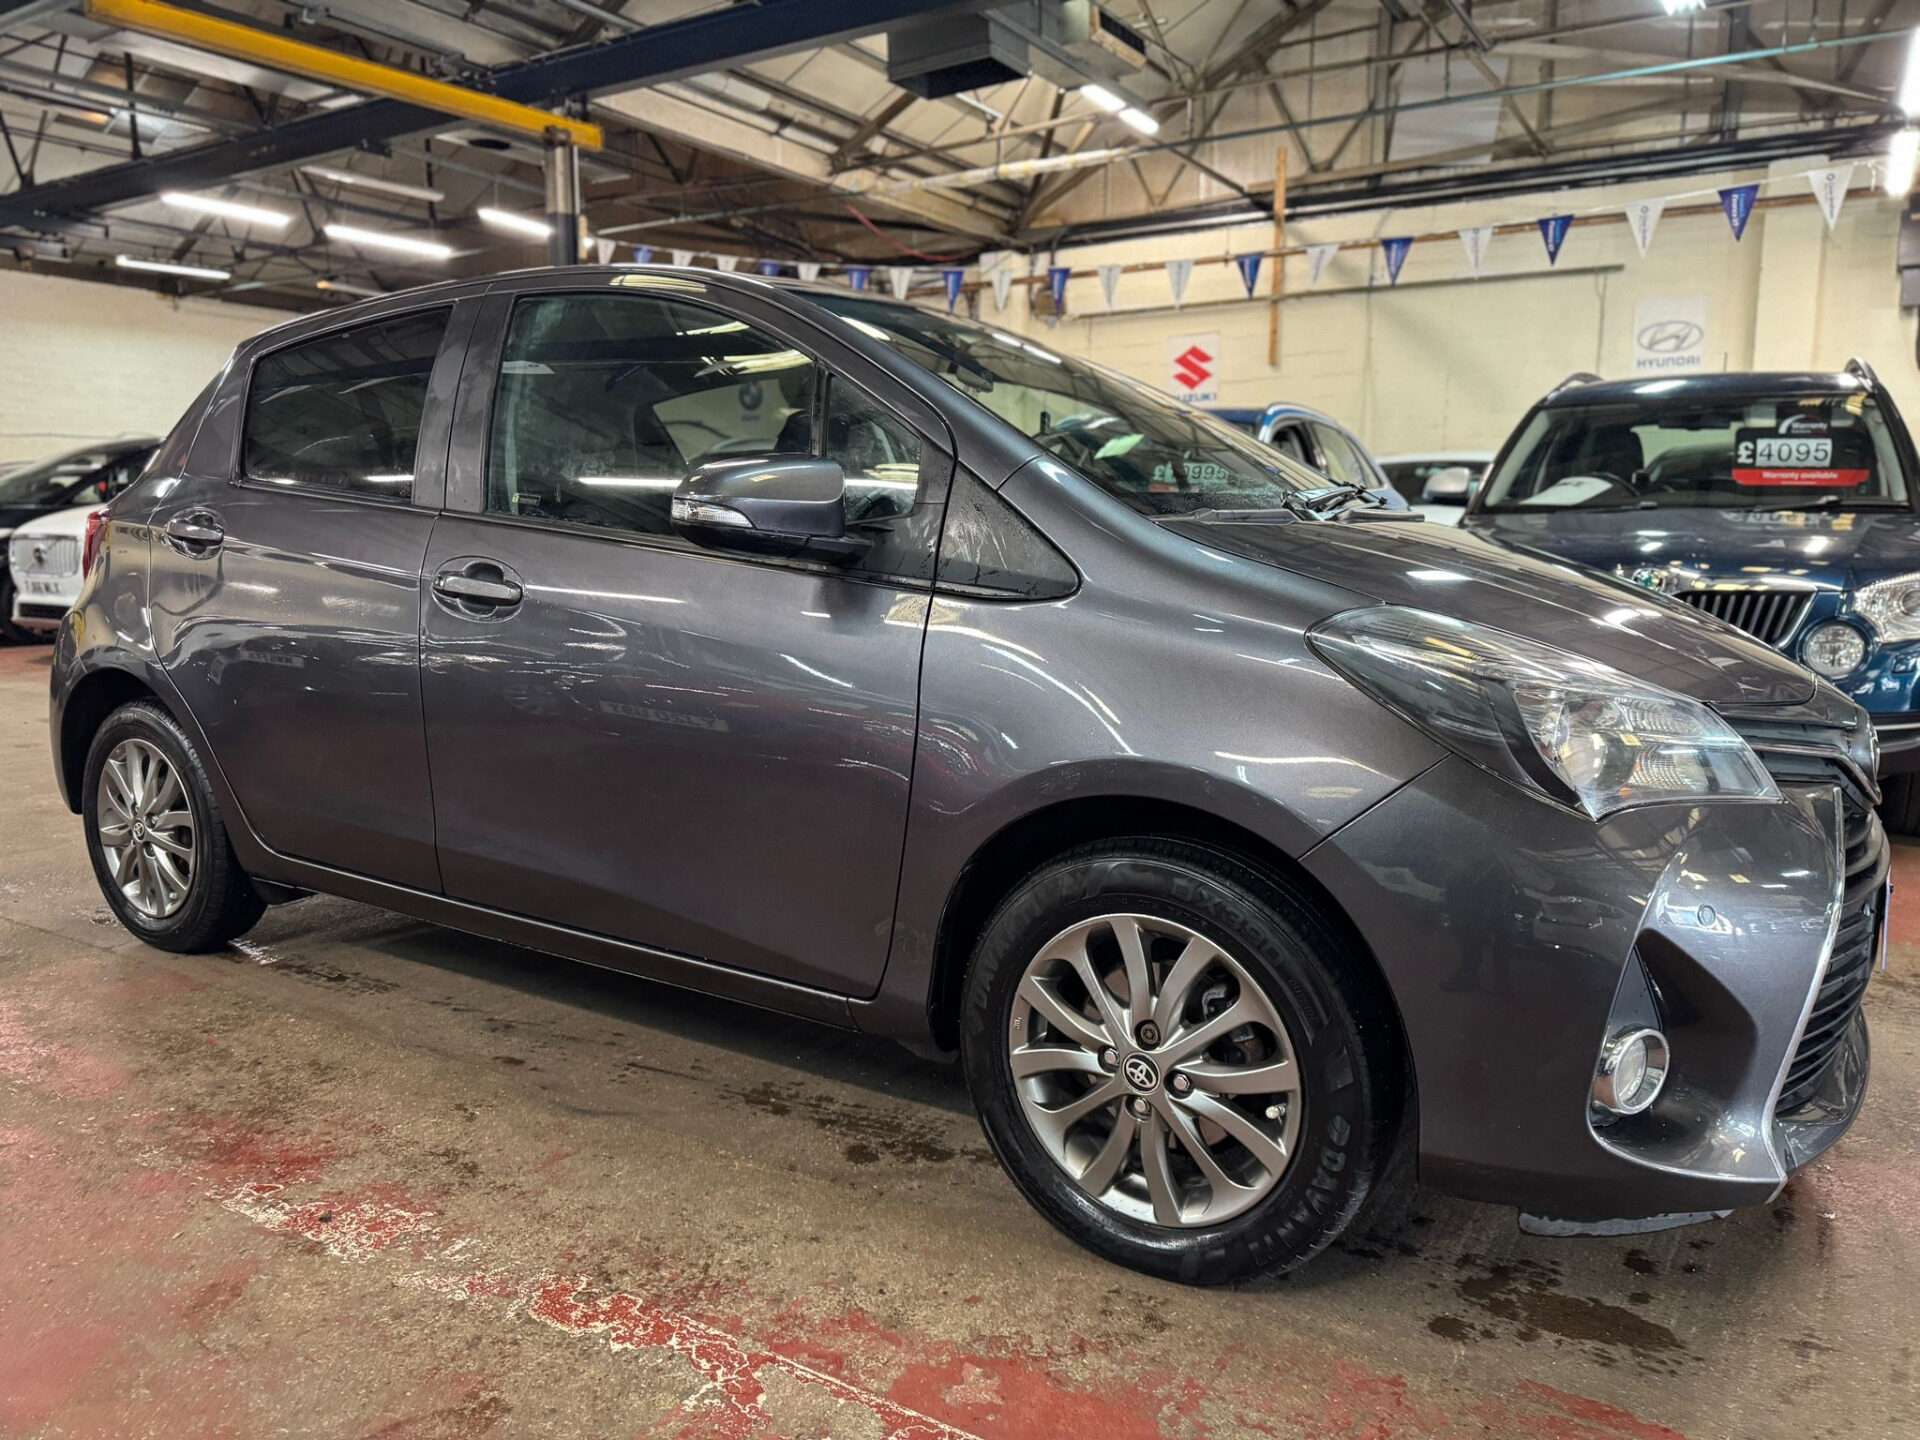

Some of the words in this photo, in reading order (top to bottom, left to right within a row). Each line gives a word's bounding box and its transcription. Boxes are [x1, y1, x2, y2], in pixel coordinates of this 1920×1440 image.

[1637, 355, 1700, 368] HYUNDAI
[1762, 471, 1799, 480] Warranty
[1800, 471, 1838, 479] available
